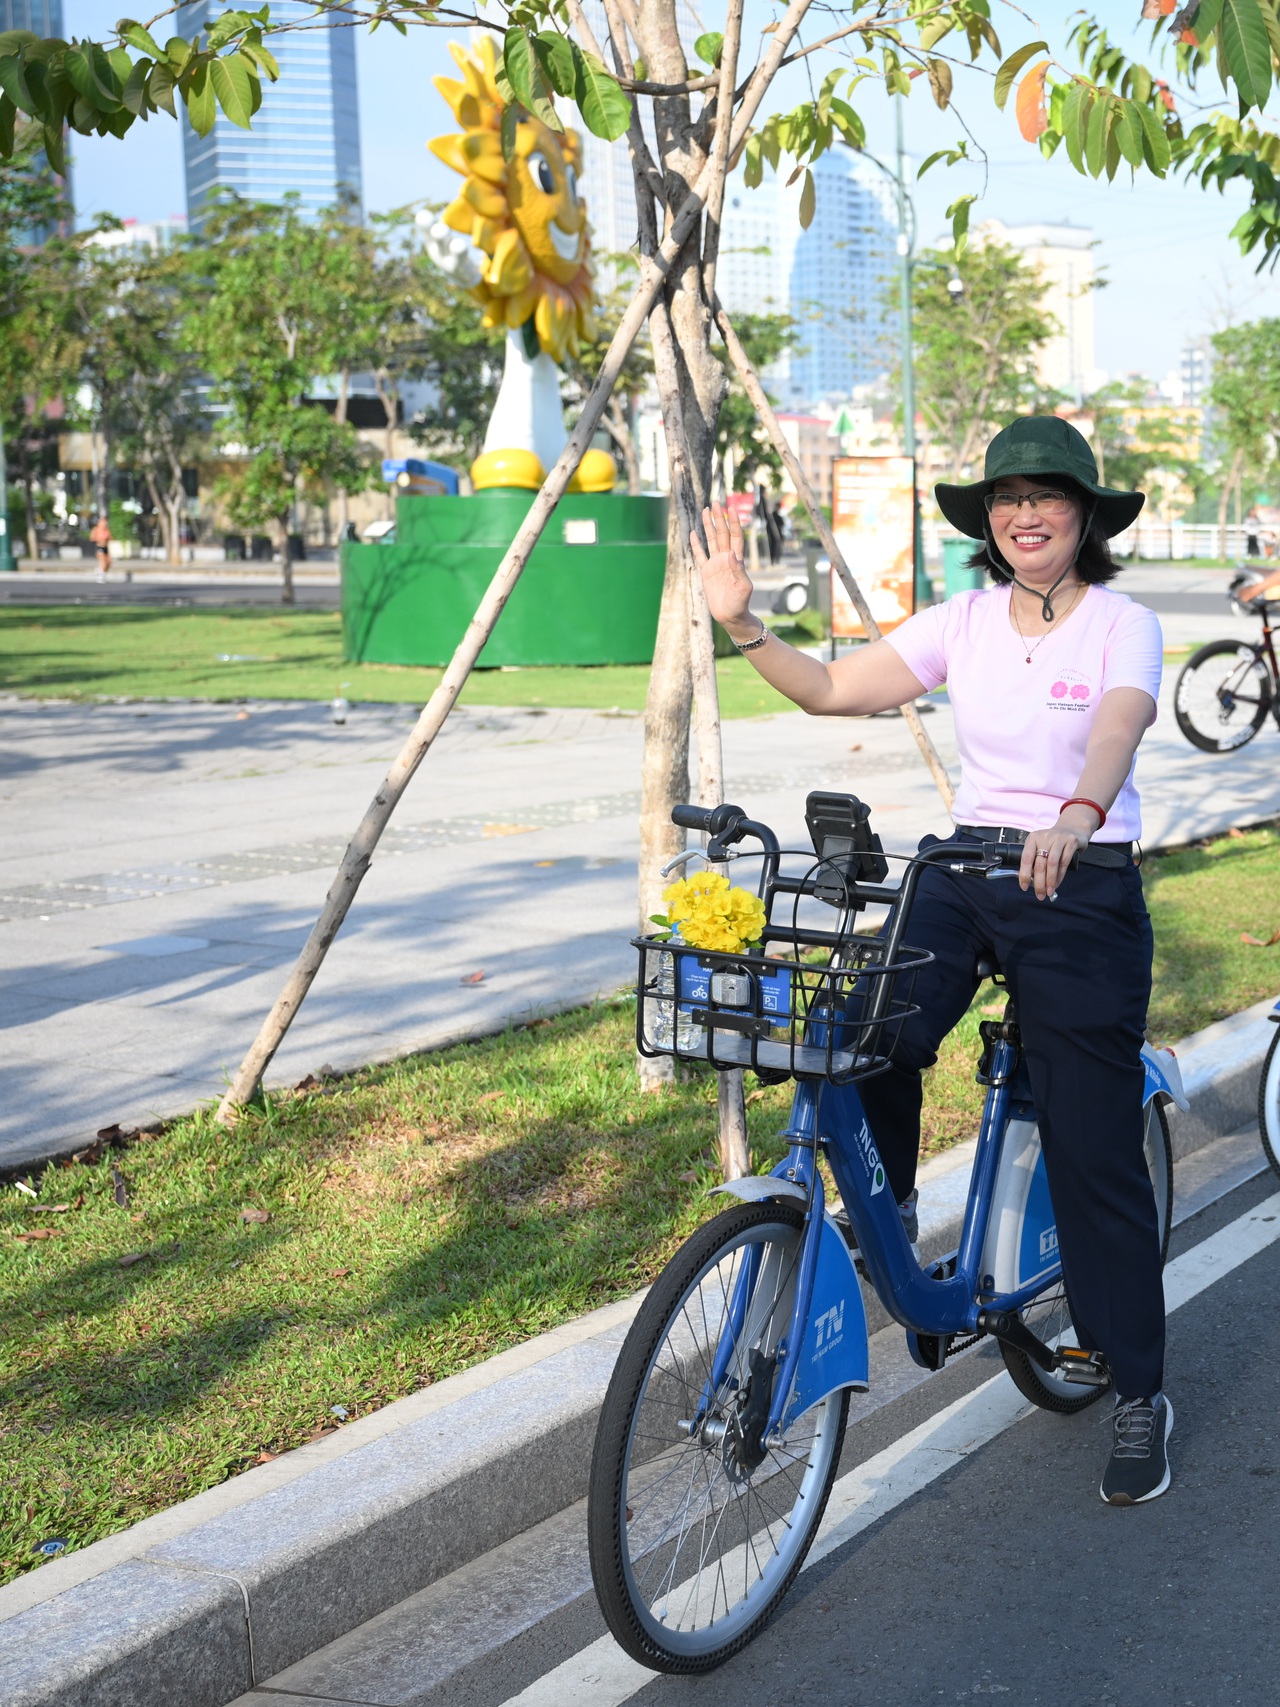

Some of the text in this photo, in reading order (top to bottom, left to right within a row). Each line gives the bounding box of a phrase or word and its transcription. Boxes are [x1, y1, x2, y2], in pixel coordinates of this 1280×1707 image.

[859, 1117, 886, 1196] TNGO
[814, 1299, 845, 1349] TN
[828, 1333, 844, 1350] GROUP
